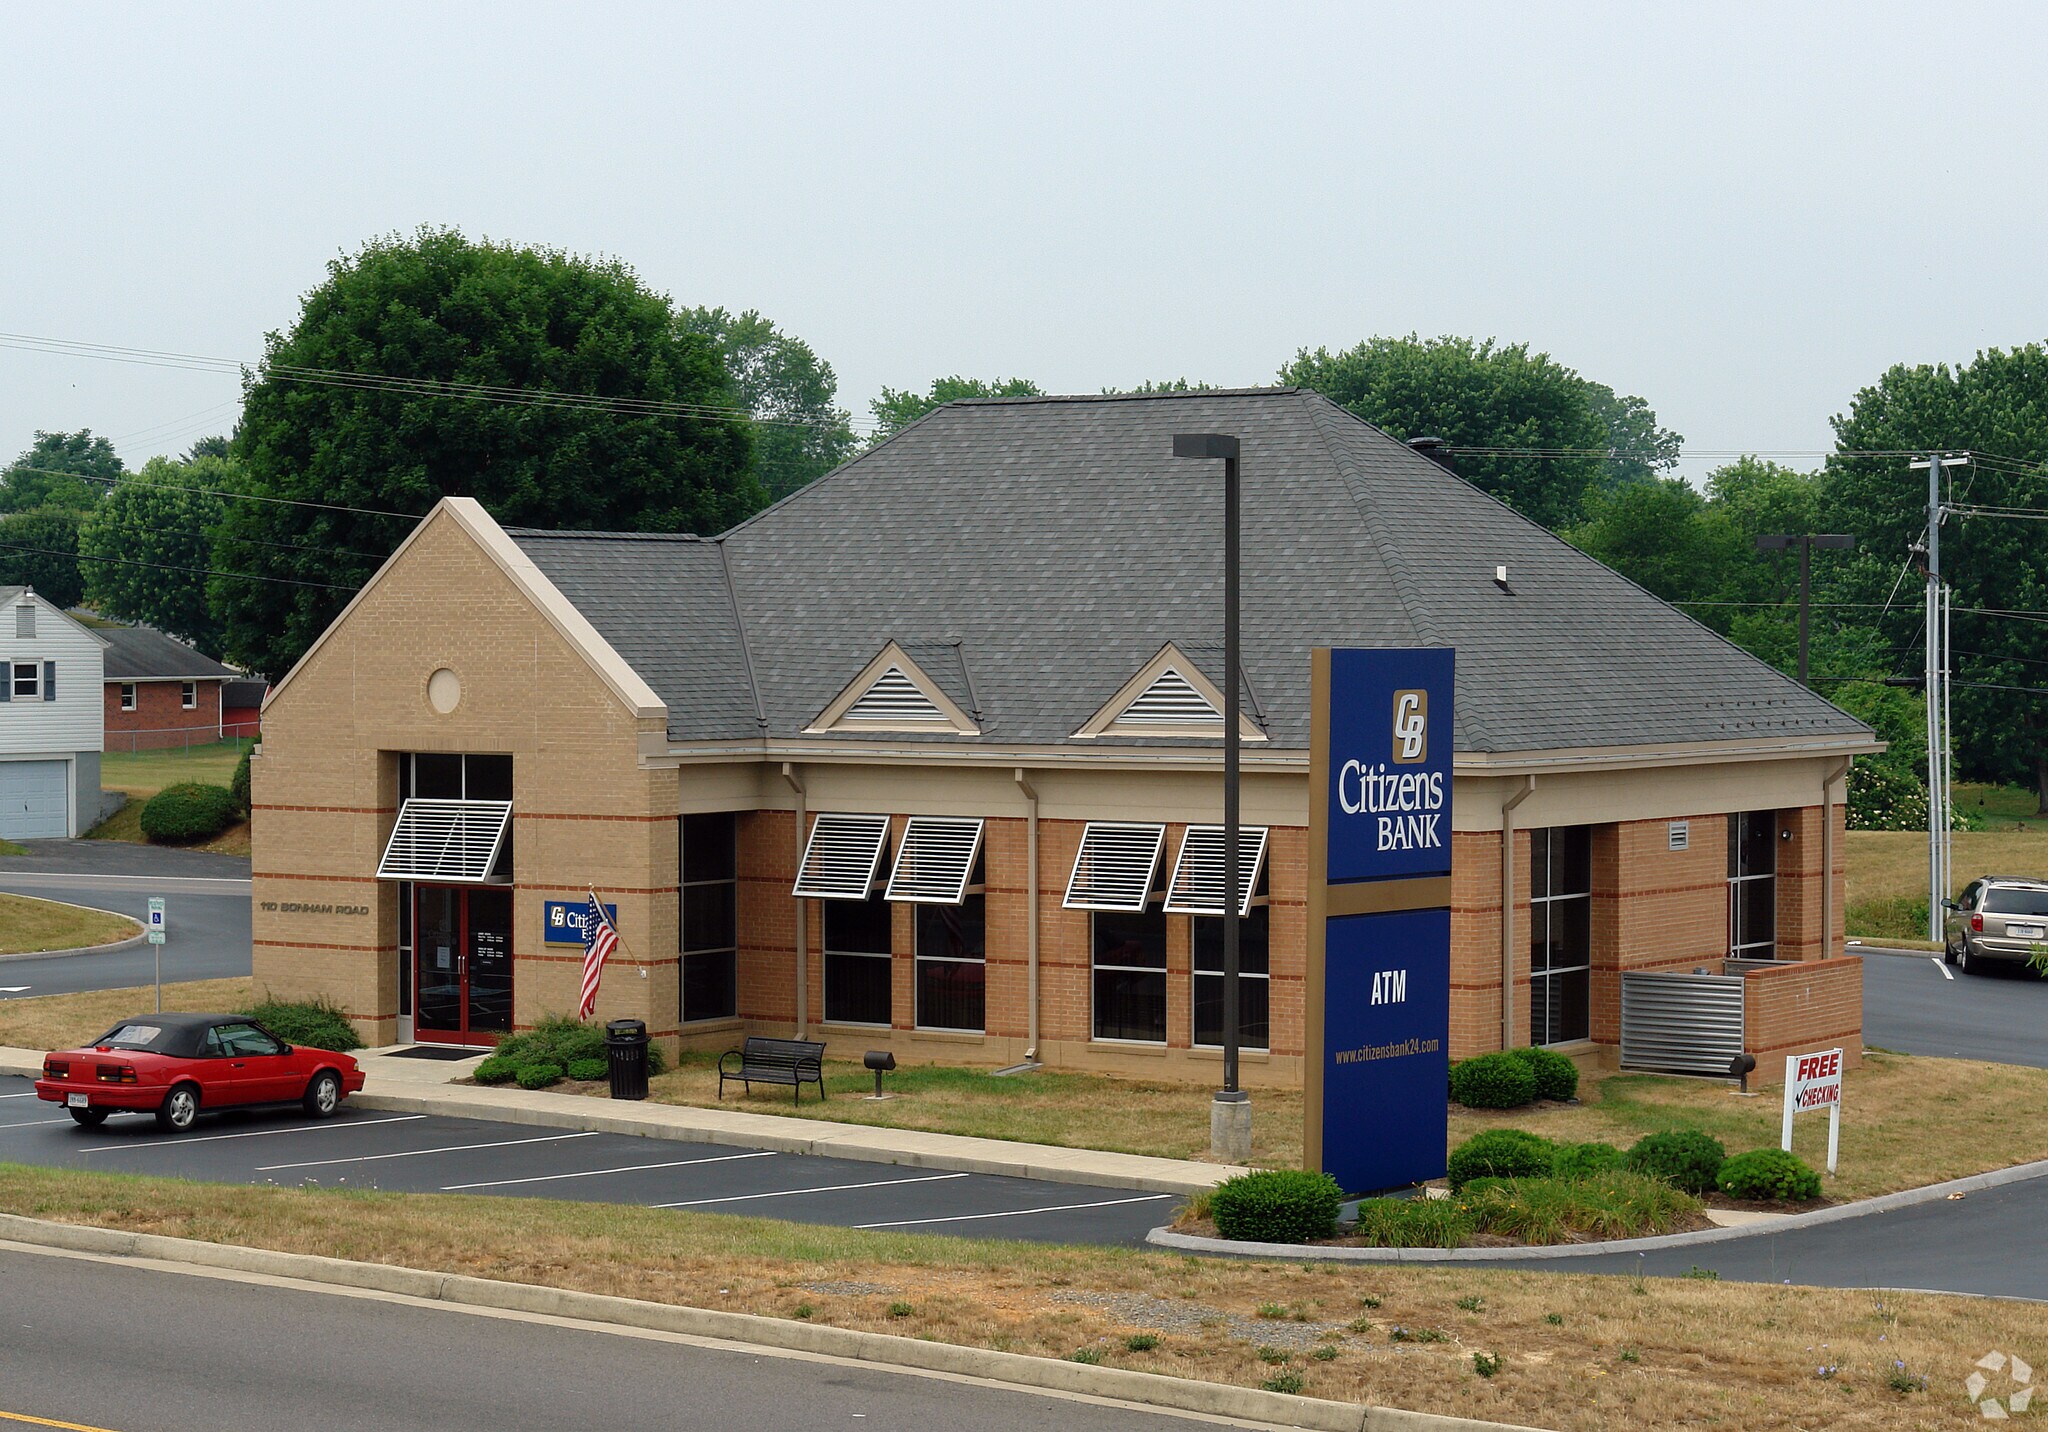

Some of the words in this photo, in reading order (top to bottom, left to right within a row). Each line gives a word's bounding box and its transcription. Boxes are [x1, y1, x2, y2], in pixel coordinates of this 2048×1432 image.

[1338, 759, 1444, 815] Citizens
[1377, 813, 1442, 851] BANK
[260, 901, 278, 912] 110
[280, 902, 333, 914] BONHAM
[335, 905, 370, 916] ROAD
[1370, 969, 1407, 1006] ATM
[1335, 1038, 1439, 1065] www.citizensbank24.com
[1797, 1053, 1840, 1082] FREE
[1801, 1083, 1839, 1108] CHECKING
